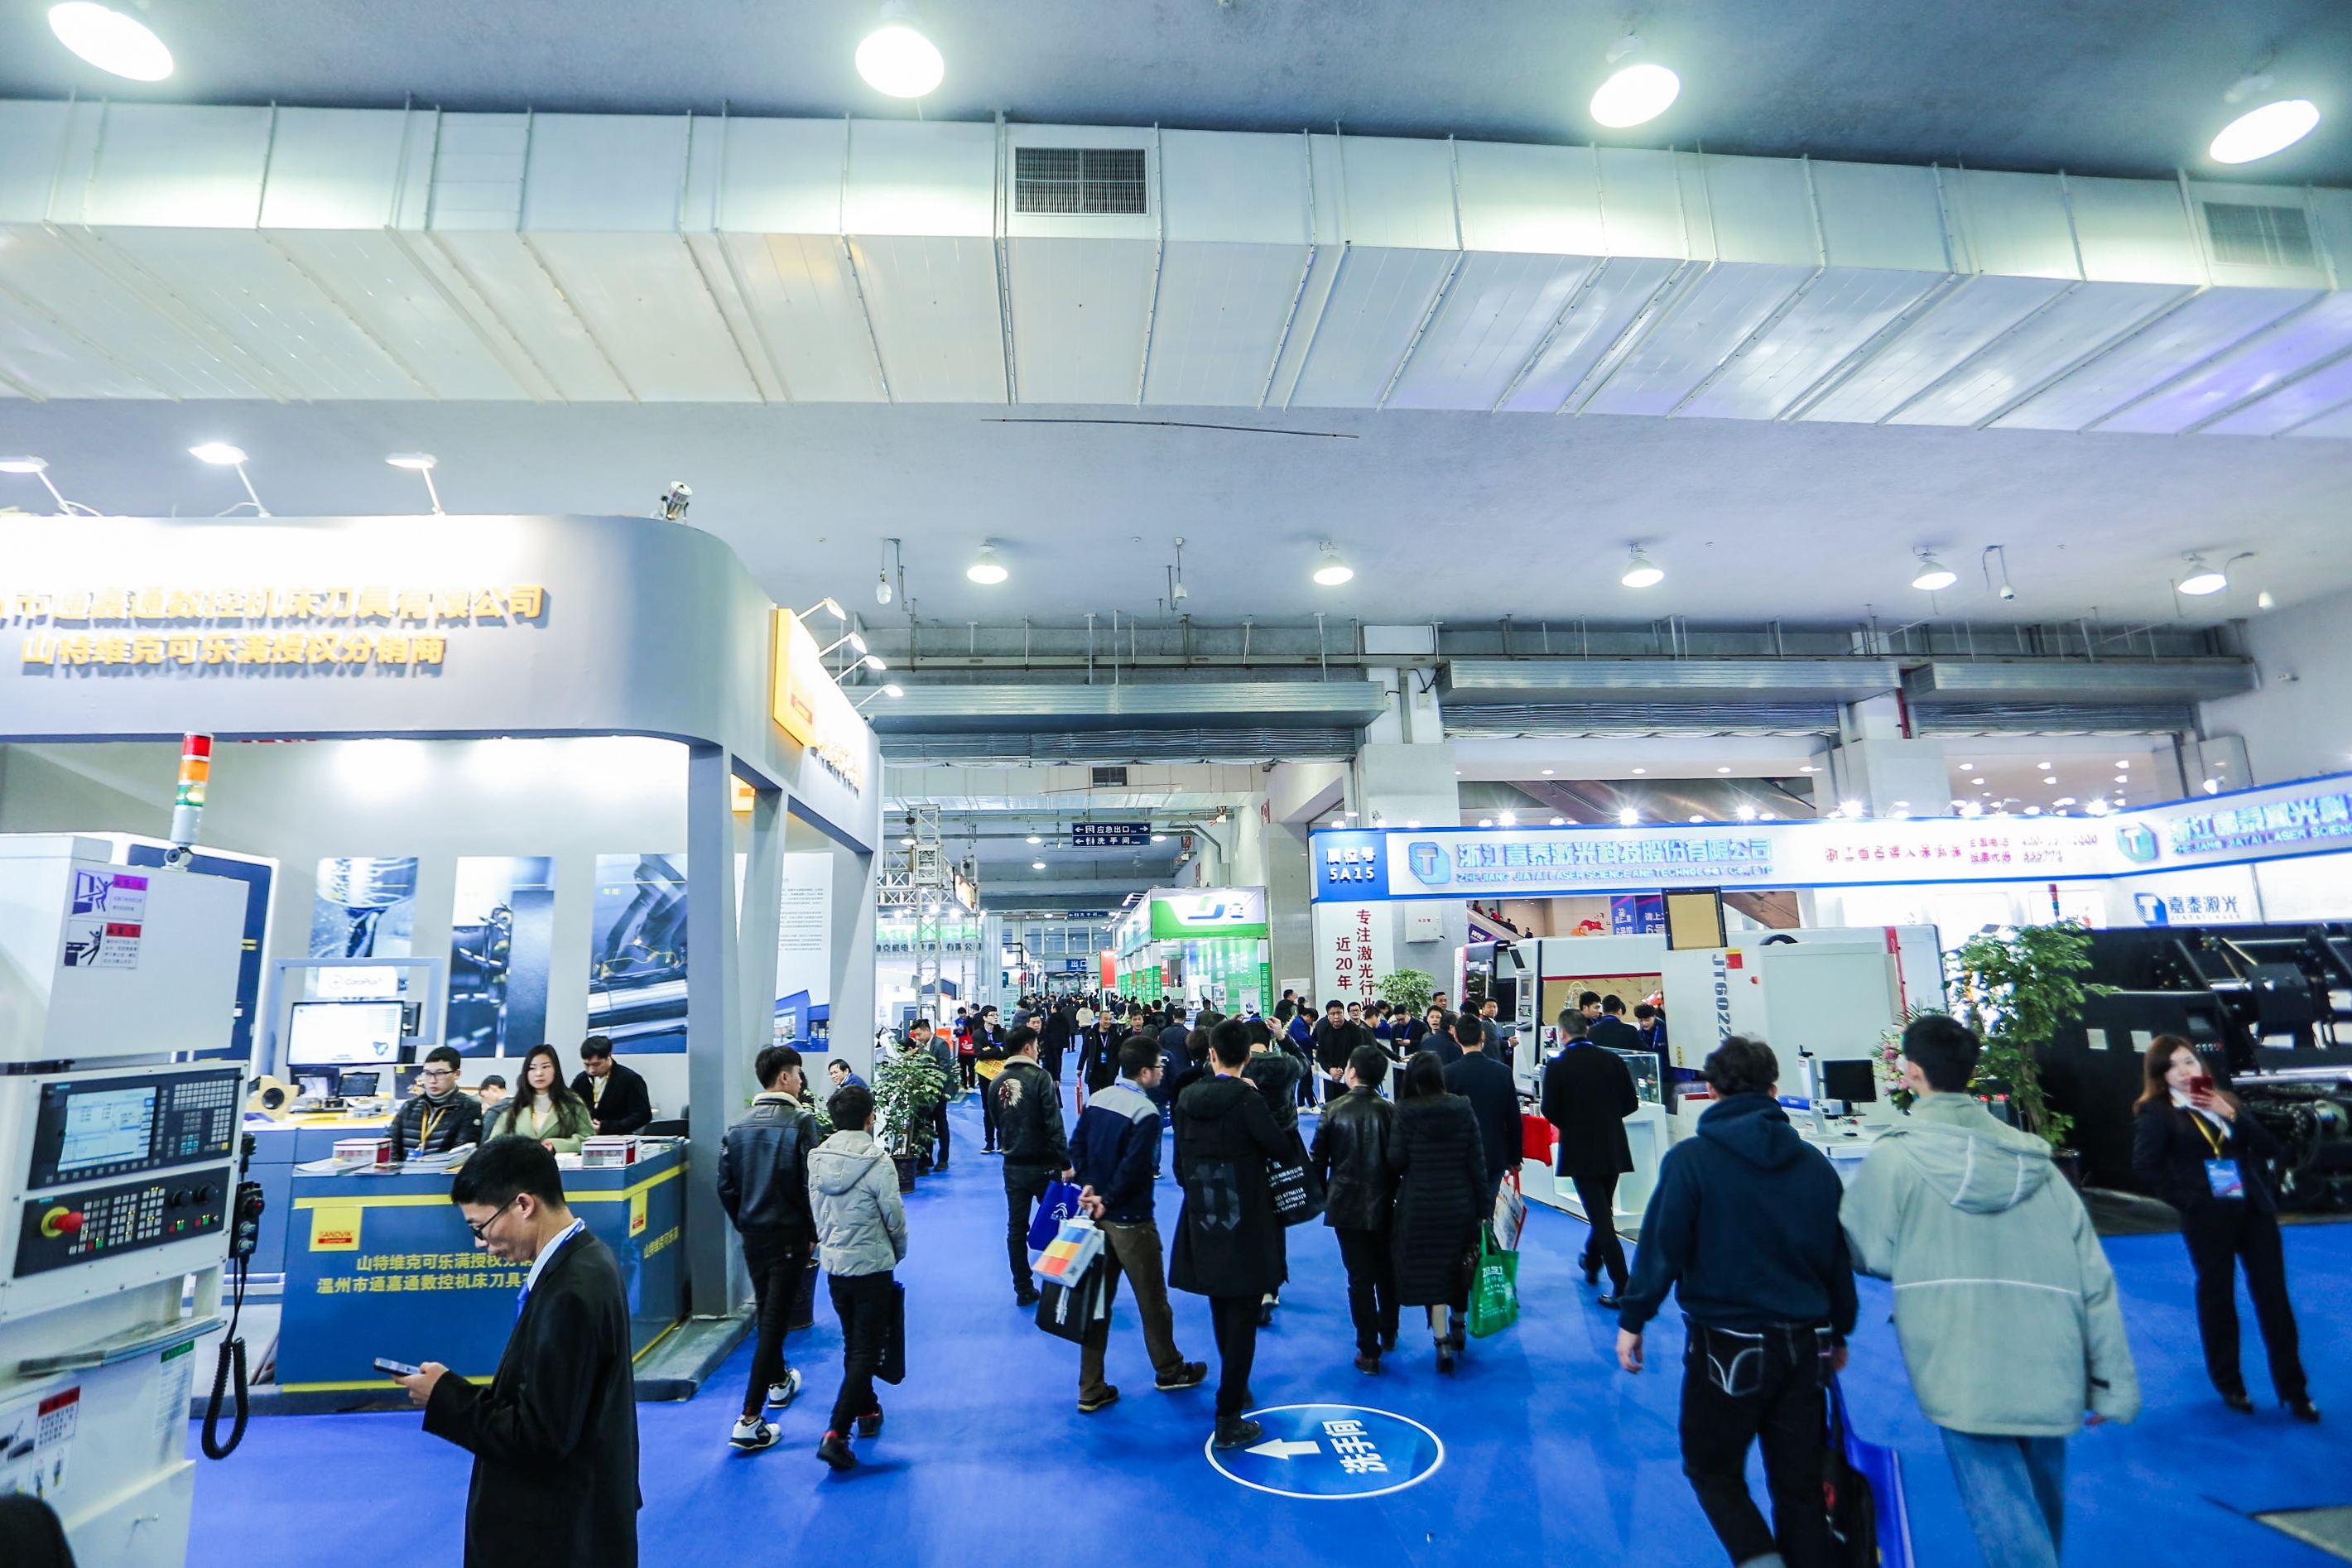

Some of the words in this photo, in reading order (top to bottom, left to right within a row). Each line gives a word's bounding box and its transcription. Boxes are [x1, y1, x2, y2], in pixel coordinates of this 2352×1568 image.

[0, 586, 543, 620] 市通嘉通数控机床刀具有限公司
[21, 632, 445, 665] 山特维克可乐满授权分销商
[1097, 825, 1130, 834] 应急出口
[1097, 836, 1130, 844] 洗手间
[1326, 846, 1376, 864] 展位号
[1455, 838, 1773, 868] 浙江嘉泰激光科技股份有限公司
[1328, 866, 1375, 881] 5A15
[1513, 872, 1546, 882] JIATAI
[2167, 896, 2239, 914] 嘉泰激光
[316, 1272, 529, 1294] 温州市通嘉通数控机床刀具
[1321, 1418, 1388, 1474] 洗手间
